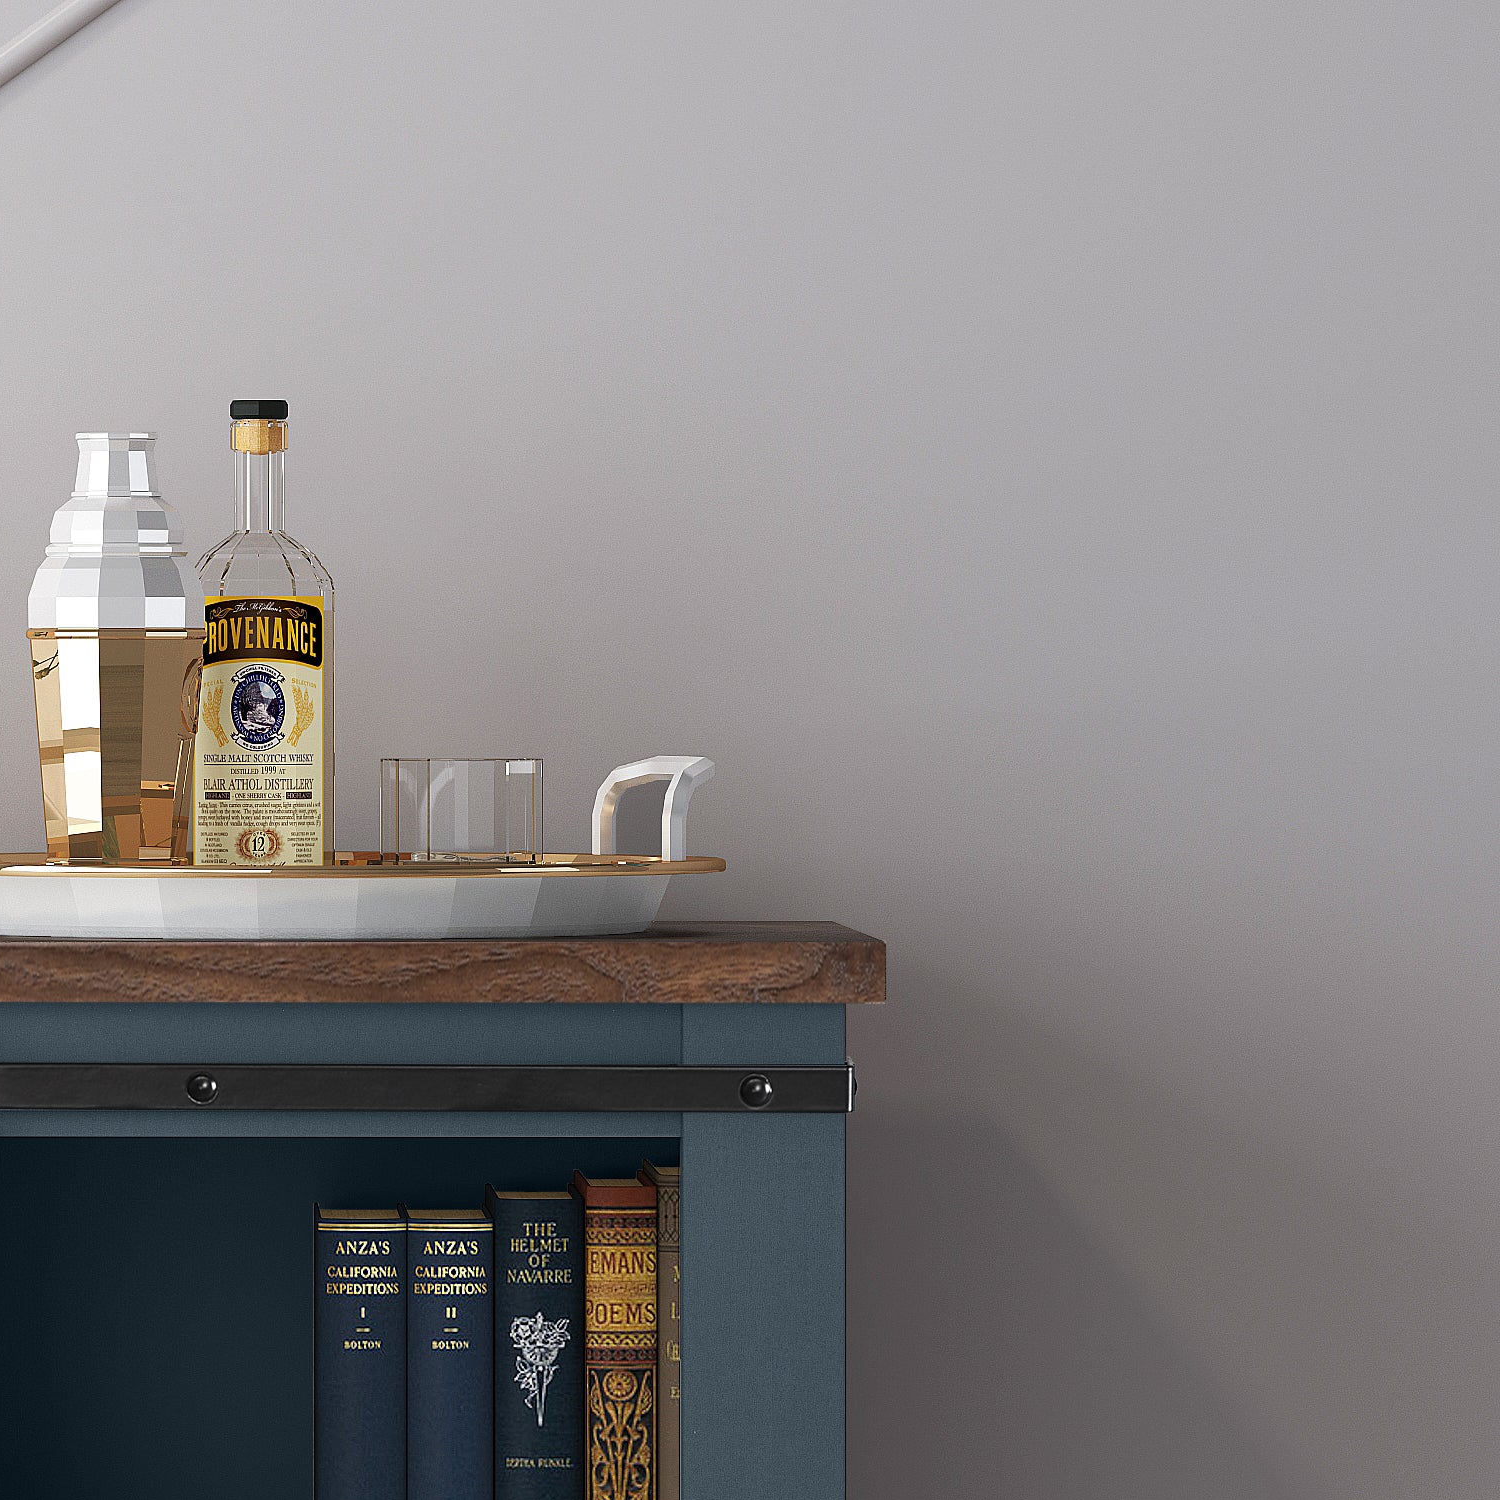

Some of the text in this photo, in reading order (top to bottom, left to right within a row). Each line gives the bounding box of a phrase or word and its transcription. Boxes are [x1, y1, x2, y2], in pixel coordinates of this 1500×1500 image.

[204, 754, 314, 763] SINGLE MALT SCOTCH WHISKY
[261, 766, 277, 775] 1999
[204, 779, 314, 790] BLAIR ATHOL DISTILLERY
[252, 836, 265, 852] 12
[523, 1222, 557, 1237] THE
[335, 1240, 390, 1255] ANZA'S
[423, 1240, 479, 1255] ANZA'S
[510, 1238, 569, 1253] HELMET
[528, 1253, 550, 1268] OF
[586, 1251, 656, 1274] EMANS
[327, 1265, 398, 1278] CALIFORNIA
[415, 1265, 487, 1278] CALIFORNIA
[506, 1269, 572, 1284] NAVARRE
[326, 1282, 399, 1295] EXPEDITIONS
[413, 1282, 487, 1295] EXPEDITIONS
[360, 1306, 366, 1319] I
[445, 1306, 457, 1319] II
[344, 1340, 381, 1350] BOLTON
[431, 1340, 469, 1350] BOLTON
